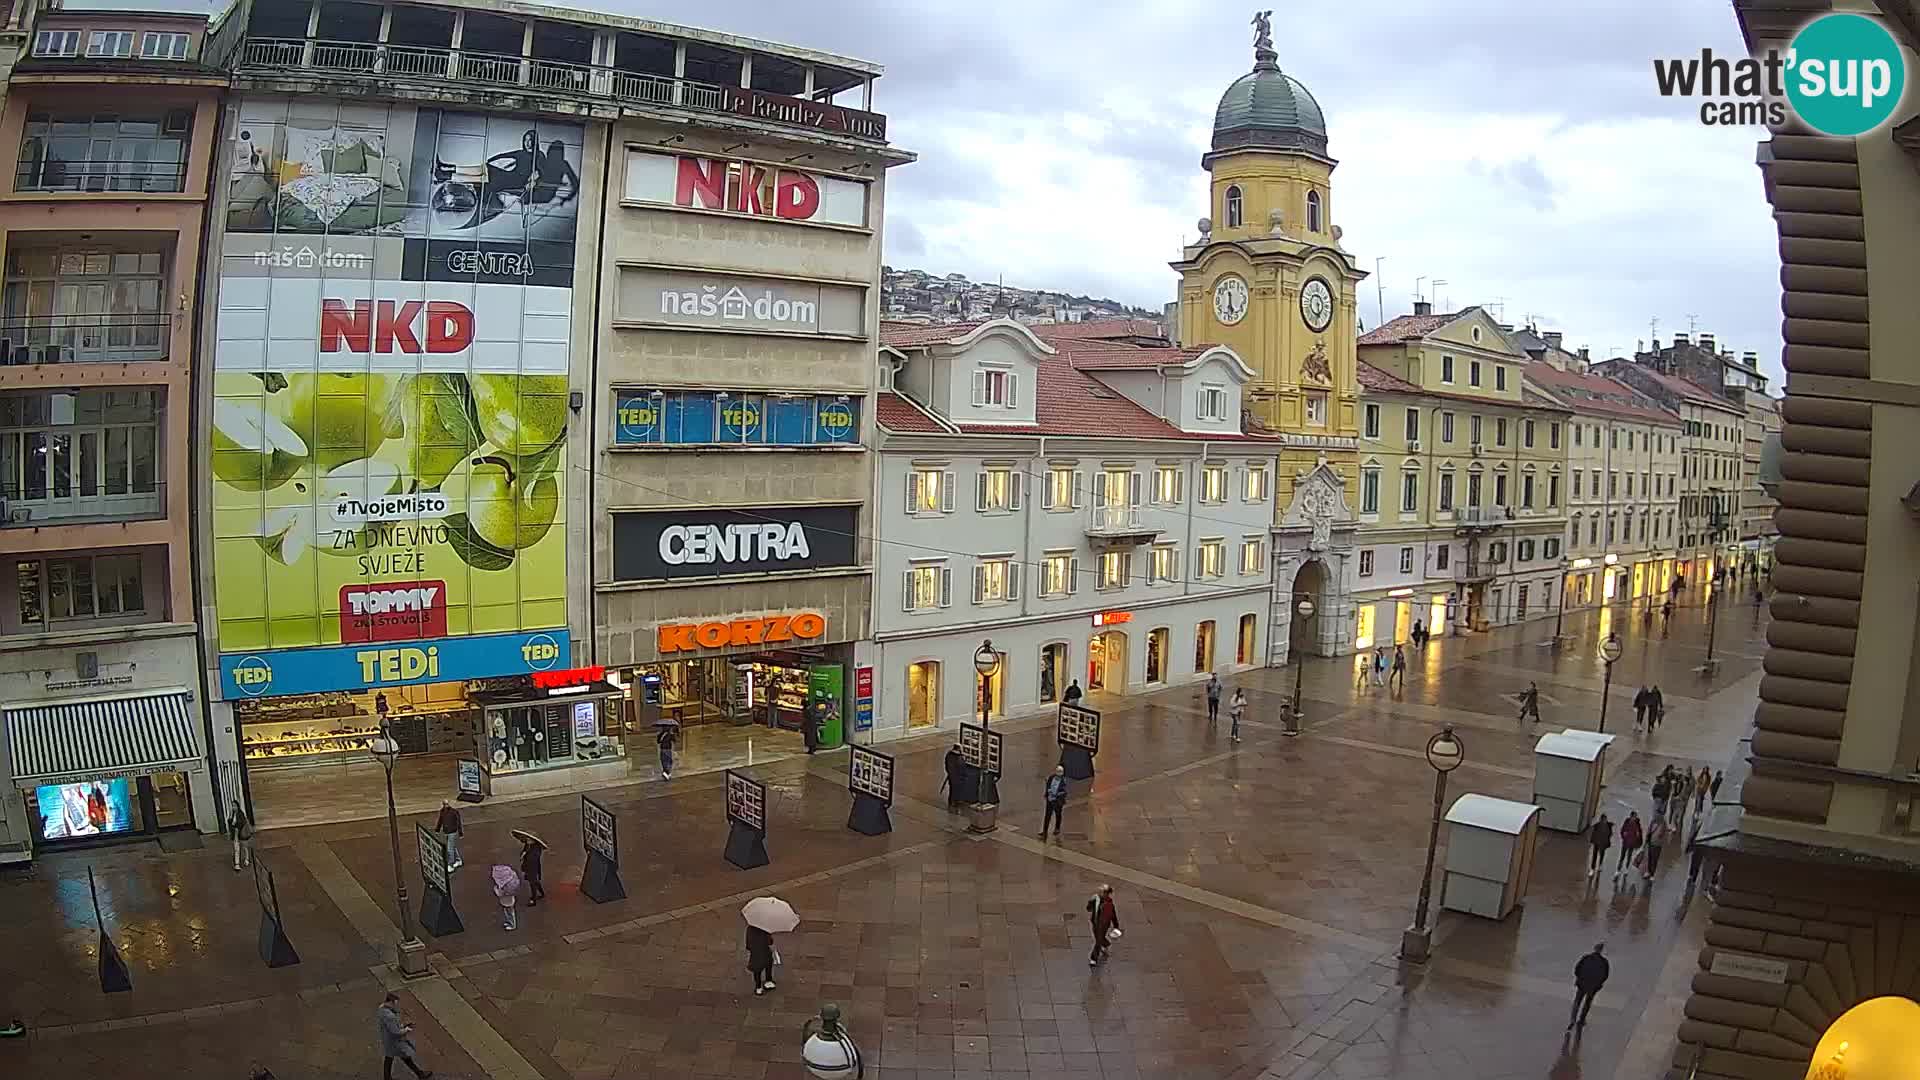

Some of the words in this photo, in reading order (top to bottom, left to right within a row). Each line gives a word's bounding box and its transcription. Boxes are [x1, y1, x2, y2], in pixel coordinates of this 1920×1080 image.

[723, 88, 745, 114] Le
[675, 155, 820, 220] NKD
[254, 245, 294, 268] naš
[319, 245, 365, 270] dom
[447, 250, 535, 277] CENTRA
[661, 285, 718, 318] naš
[753, 290, 817, 324] dom
[319, 298, 475, 355] NKD
[618, 408, 657, 425] TEDi
[723, 409, 760, 426] TEDi
[820, 411, 853, 427] TEDi
[337, 497, 445, 517] #TvojeMisto
[332, 529, 356, 550] ZA
[367, 523, 450, 548] DNEVNO
[658, 522, 811, 565] CENTRA
[358, 549, 425, 576] SVJEŽE
[348, 587, 438, 615] TOMMY
[658, 613, 825, 653] KORZO
[357, 646, 439, 683] TEDi
[522, 643, 560, 661] TEDi
[233, 667, 273, 684] TEDi
